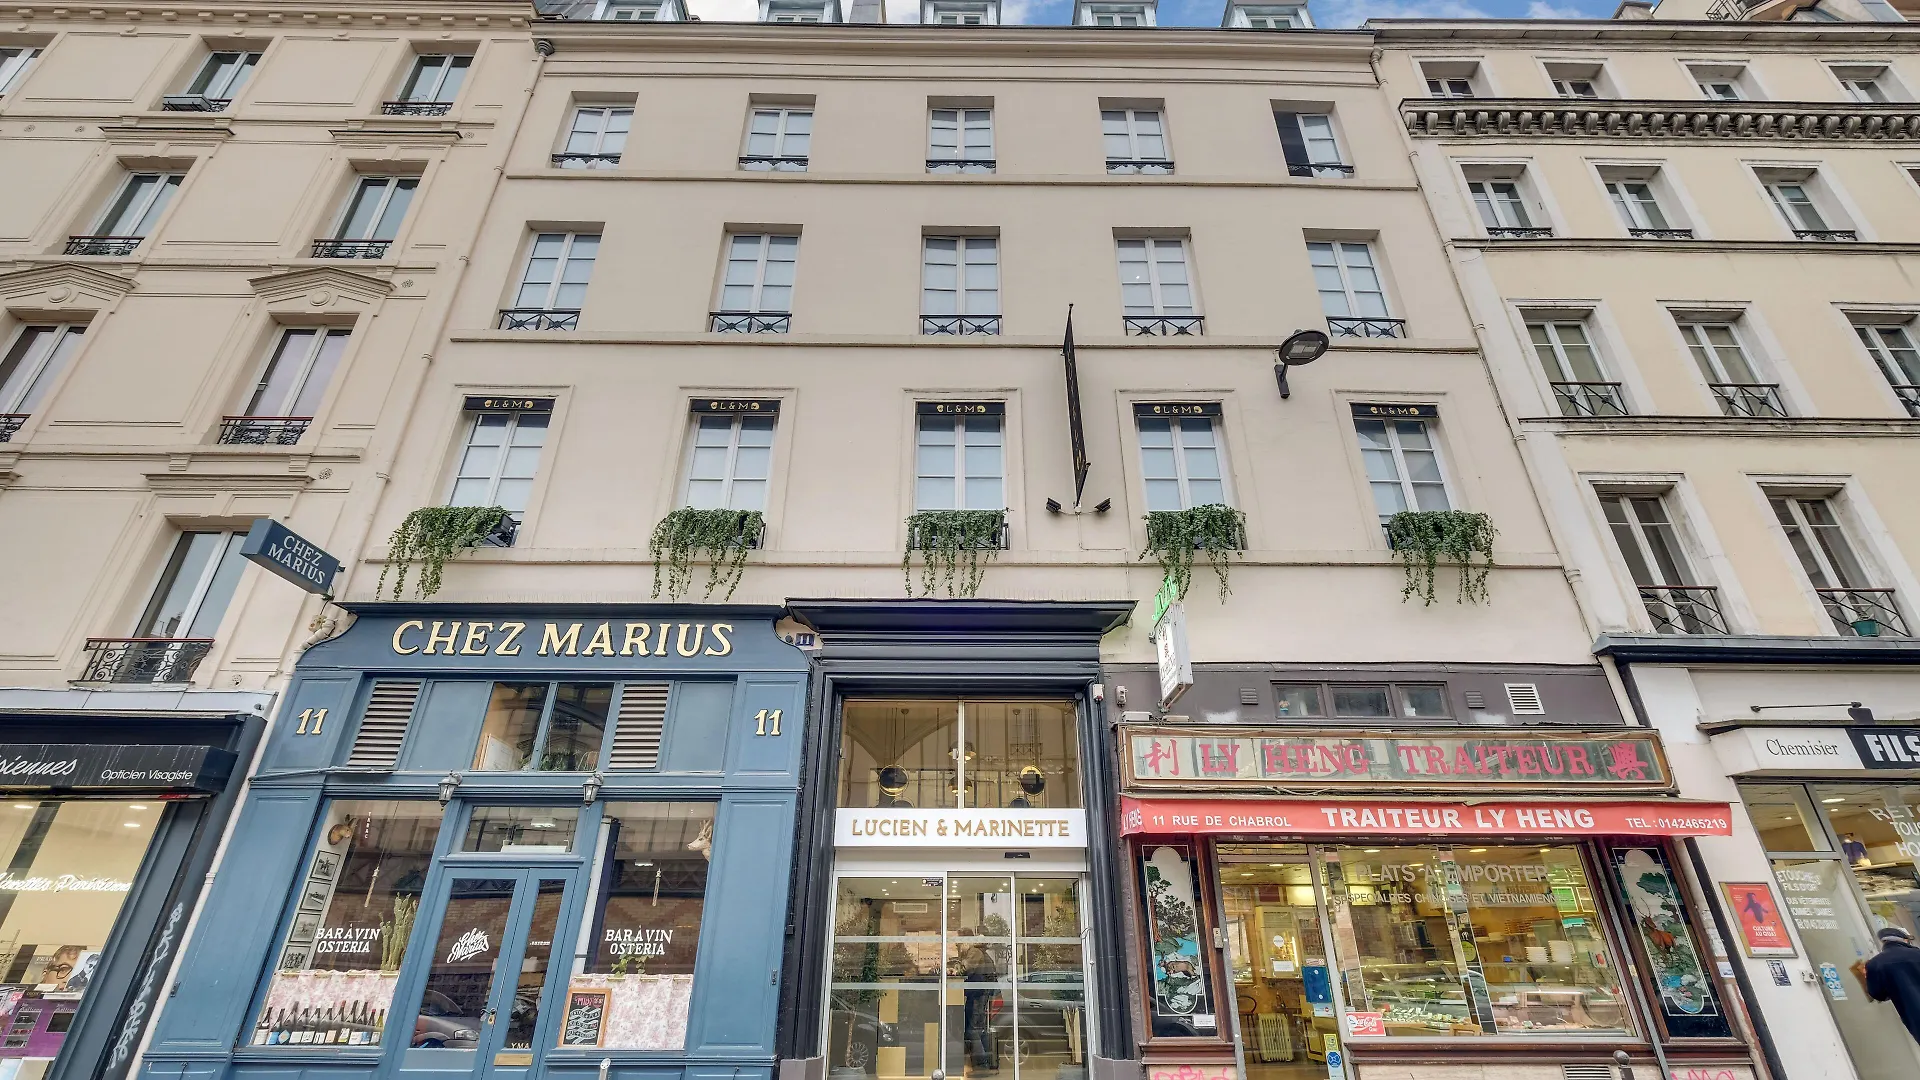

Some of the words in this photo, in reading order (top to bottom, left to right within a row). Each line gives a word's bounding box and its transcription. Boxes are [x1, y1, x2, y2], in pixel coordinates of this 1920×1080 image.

[283, 535, 323, 567] CHEZ
[267, 543, 326, 585] MARIUS
[392, 620, 528, 656] CHEZ
[536, 621, 735, 657] MARIUS
[799, 634, 810, 645] 11
[296, 708, 329, 735] 11
[753, 709, 783, 737] 11
[1766, 738, 1840, 756] Chemisier
[0, 755, 78, 776] siennes
[1144, 739, 1179, 776] 利
[1199, 743, 1240, 773] LY
[1261, 744, 1370, 774] HENG
[1397, 745, 1595, 775] TRAITEUR
[101, 769, 146, 781] Opticien
[149, 769, 193, 781] Visagiste
[1152, 815, 1165, 826] 11
[1172, 815, 1199, 826] RUE
[1205, 815, 1223, 826] DE
[1229, 816, 1292, 827] CHABROL
[1321, 807, 1463, 828] TRAITEUR
[1475, 809, 1506, 828] LY
[1515, 809, 1595, 829] HENG
[1868, 805, 1920, 822] RET
[364, 811, 372, 839] TABAC
[852, 819, 928, 837] LUCIEN
[936, 818, 948, 837] &
[954, 819, 1071, 837] MARINETTE
[1894, 841, 1920, 857] HO
[1354, 864, 1416, 882] PLATS
[1443, 864, 1548, 882] EMPORTER
[314, 928, 344, 939] BAR
[354, 928, 381, 941] VIN
[605, 929, 633, 942] BAR
[645, 929, 674, 944] VIN
[317, 941, 371, 953] OSTERIA
[609, 942, 666, 955] OSTERIA
